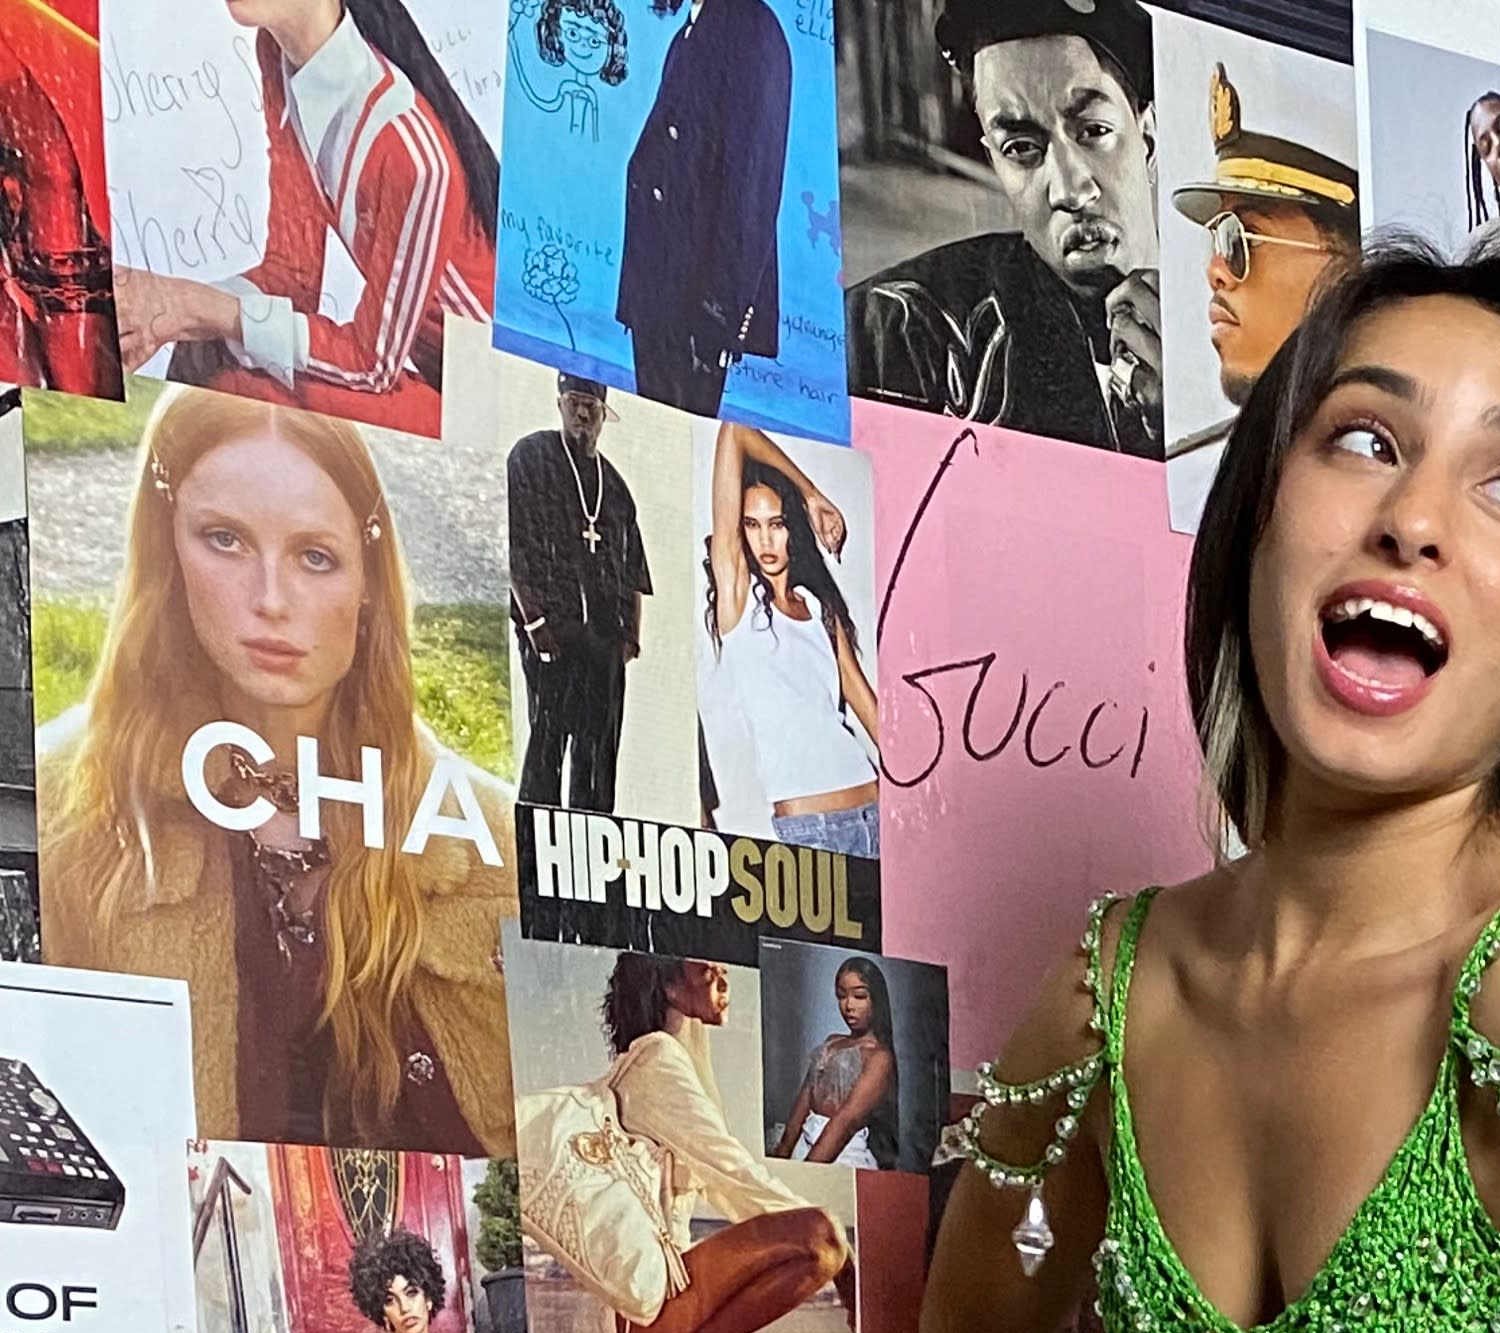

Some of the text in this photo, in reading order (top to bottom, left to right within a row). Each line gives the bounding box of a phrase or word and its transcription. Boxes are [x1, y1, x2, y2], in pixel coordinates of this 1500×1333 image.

[537, 215, 615, 266] favorite
[799, 378, 839, 404] hair
[181, 720, 506, 867] CHA
[6, 1283, 98, 1321] OF
